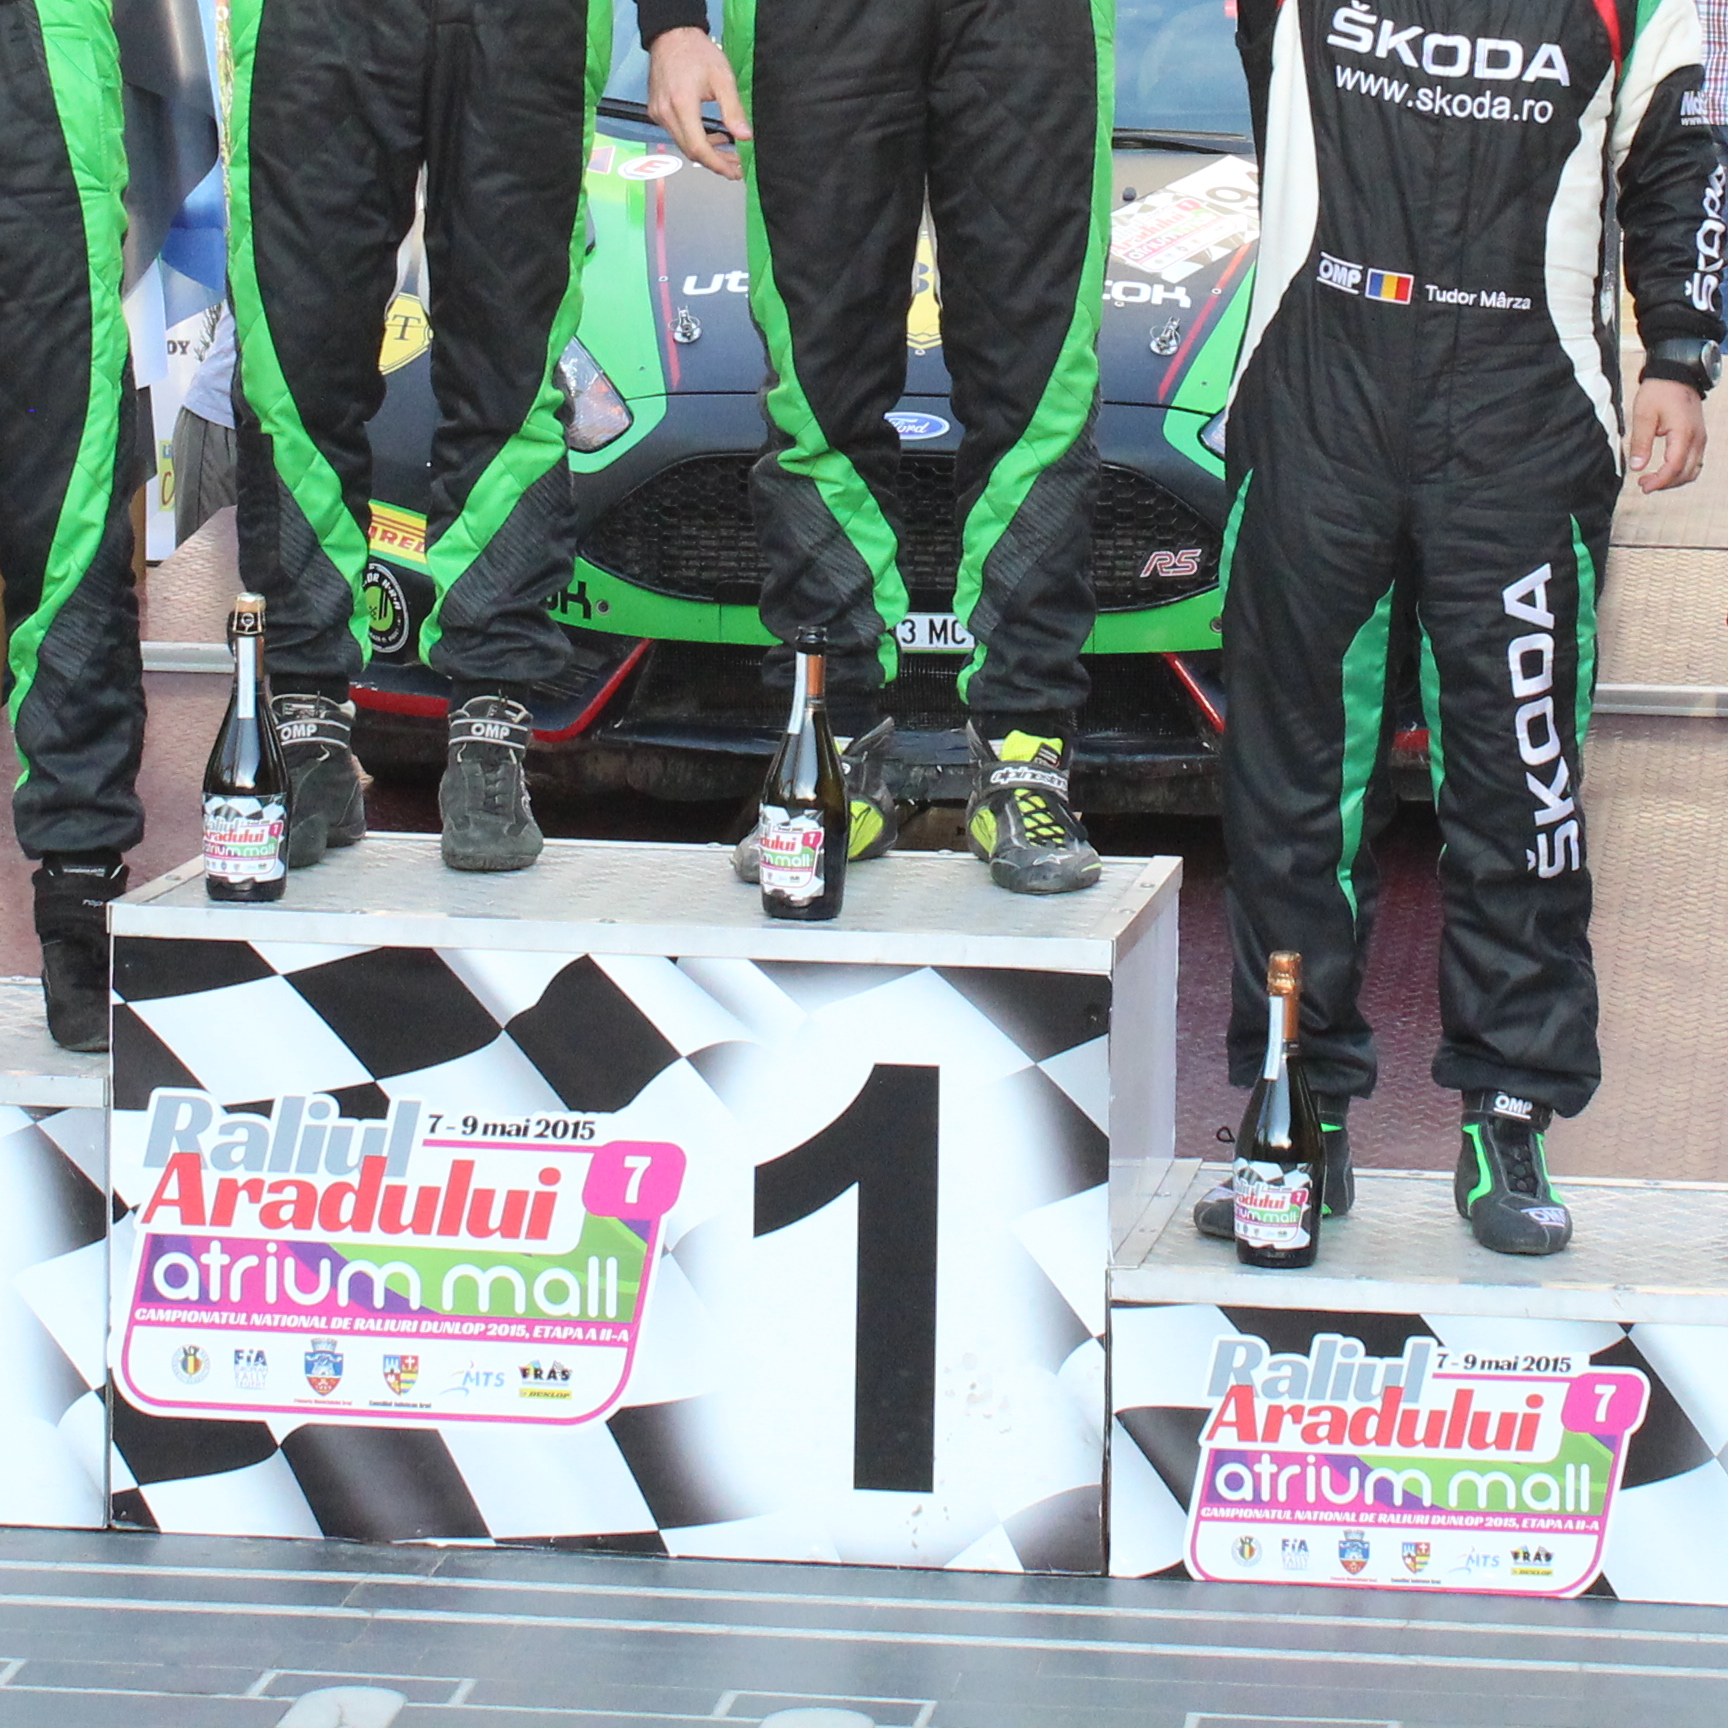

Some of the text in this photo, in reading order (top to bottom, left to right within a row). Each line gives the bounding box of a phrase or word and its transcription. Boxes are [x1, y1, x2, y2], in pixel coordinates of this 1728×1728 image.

[1335, 63, 1554, 125] www.skoda.ro
[1318, 258, 1533, 311] OMP Tudor Mârza
[1139, 549, 1203, 578] RS
[280, 722, 318, 740] OMP
[470, 722, 511, 739] OMP
[1502, 560, 1581, 880] ŠKODA
[427, 1114, 596, 1141] 7 9 mai 2015
[1494, 1093, 1534, 1115] OMP
[141, 1094, 423, 1178] Raliul
[140, 1150, 561, 1241] Aradului
[622, 1155, 653, 1204] 7
[151, 1238, 618, 1320] atrium mall
[753, 1061, 941, 1494] 1
[134, 1308, 630, 1344] CAMPIONATUL NATIONAL DE RALIURI DUNLOP 2015, ETAPA II-A
[518, 1364, 572, 1384] FRAS
[1206, 1338, 1435, 1404] Raliul
[1435, 1352, 1572, 1374] 7 9 mai 2015
[1205, 1383, 1545, 1452] Aradului
[1592, 1383, 1618, 1424] 7
[1214, 1452, 1591, 1514] atrium mall
[1200, 1506, 1600, 1533] CAMPIONATUL NATIONAL DE RALIURI DUNLOP 2015, ETAPA II-A
